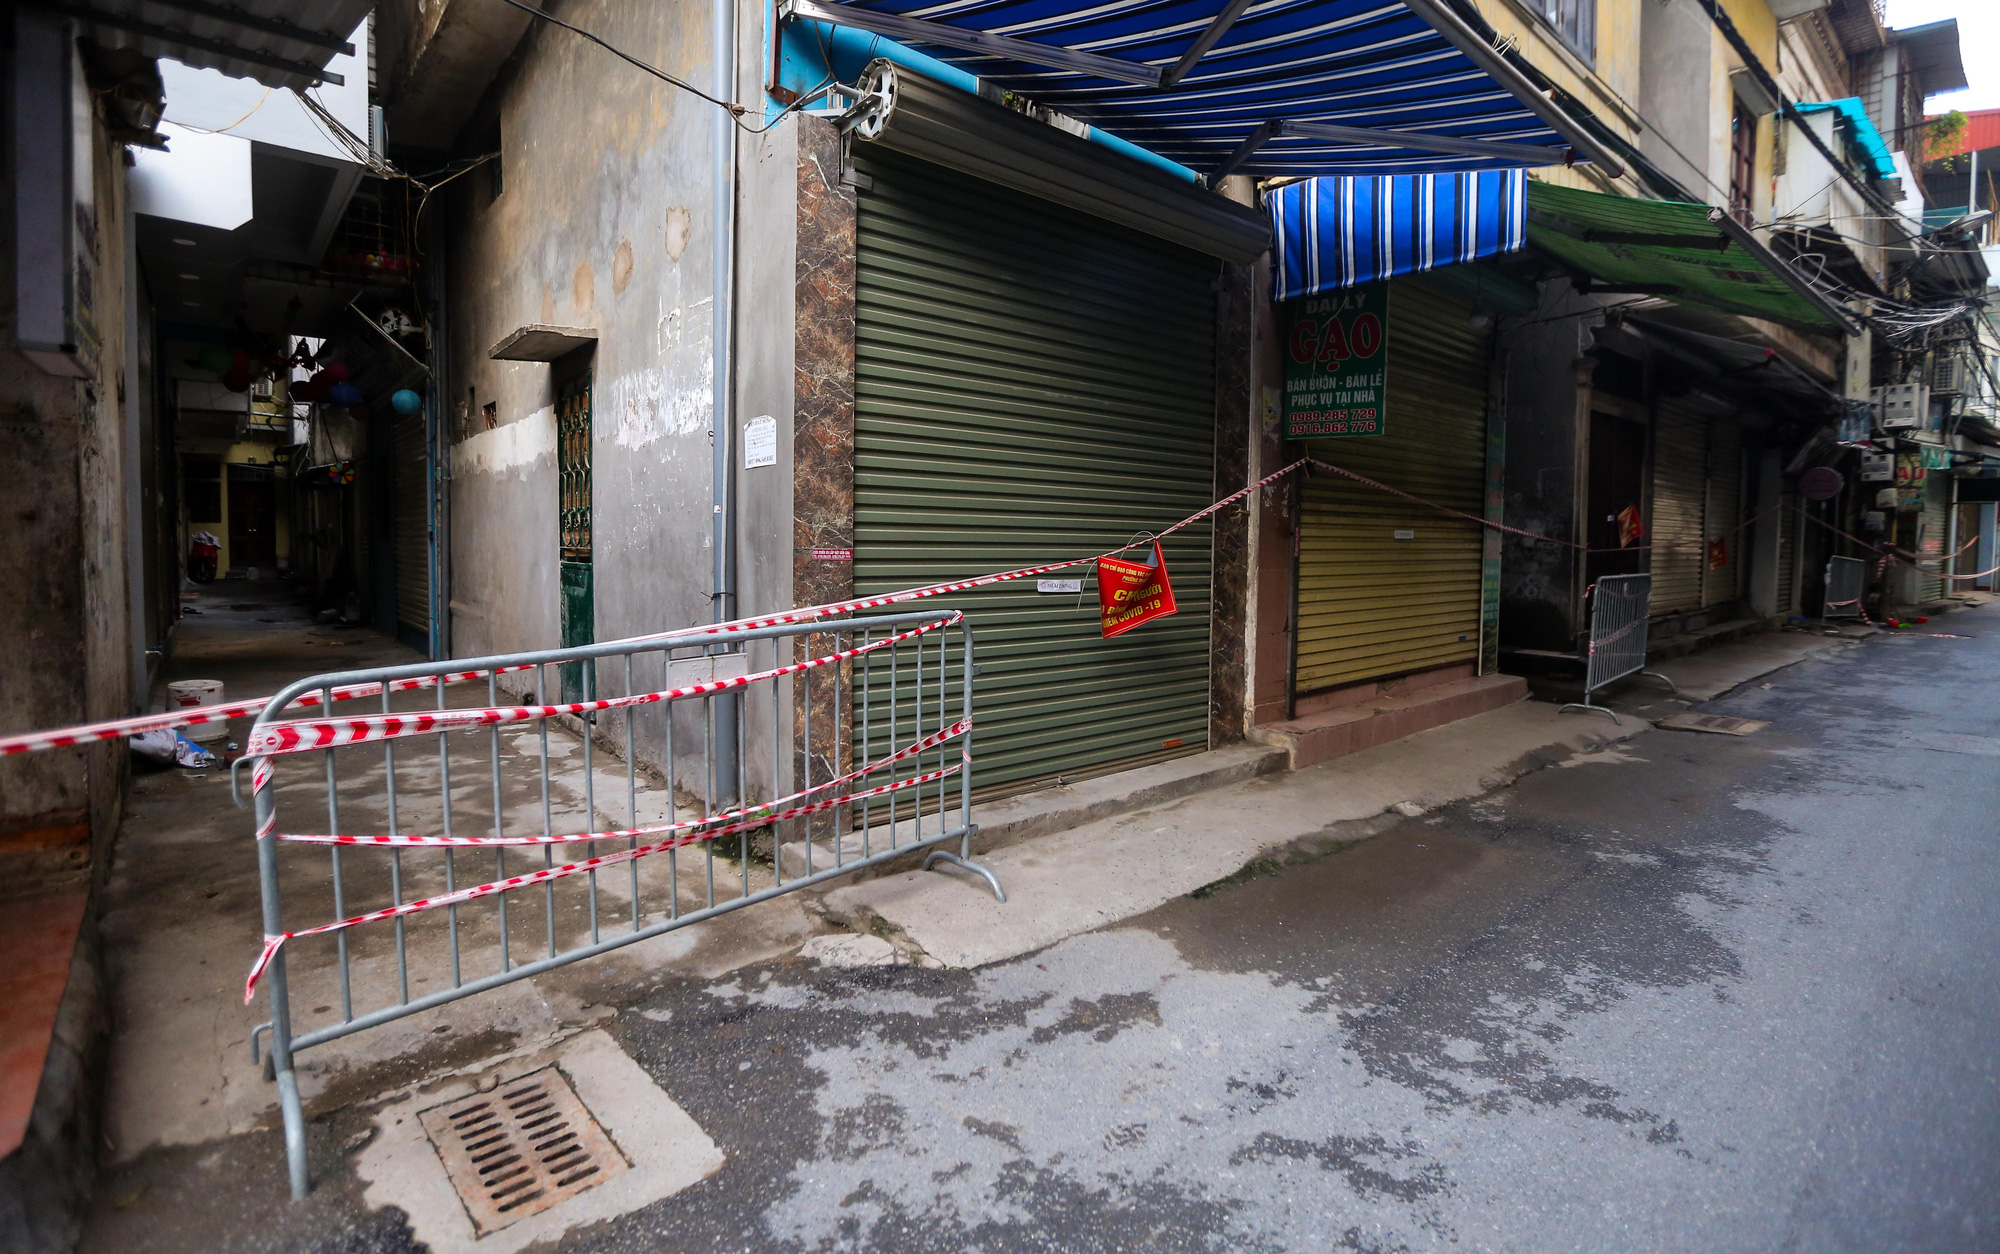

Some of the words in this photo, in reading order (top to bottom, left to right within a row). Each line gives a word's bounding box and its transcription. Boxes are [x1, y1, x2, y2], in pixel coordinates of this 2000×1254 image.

[1306, 296, 1338, 315] ĐẠI
[1345, 291, 1367, 309] LÝ
[1290, 312, 1382, 372] GẠO
[1287, 376, 1306, 392] BÁN
[1309, 375, 1336, 390] BUÔN
[1346, 372, 1367, 388] BÁN
[1370, 368, 1382, 386] LẺ
[1291, 393, 1317, 409] PHỤC
[1320, 392, 1333, 407] VỤ
[1336, 391, 1350, 407] TẠI
[1354, 387, 1375, 403] NHÀ
[1290, 410, 1348, 423] 0989.285
[1351, 408, 1376, 419] 729
[1290, 422, 1348, 435] 0916.862
[1351, 421, 1376, 432] 776
[1118, 605, 1144, 623] COVID
